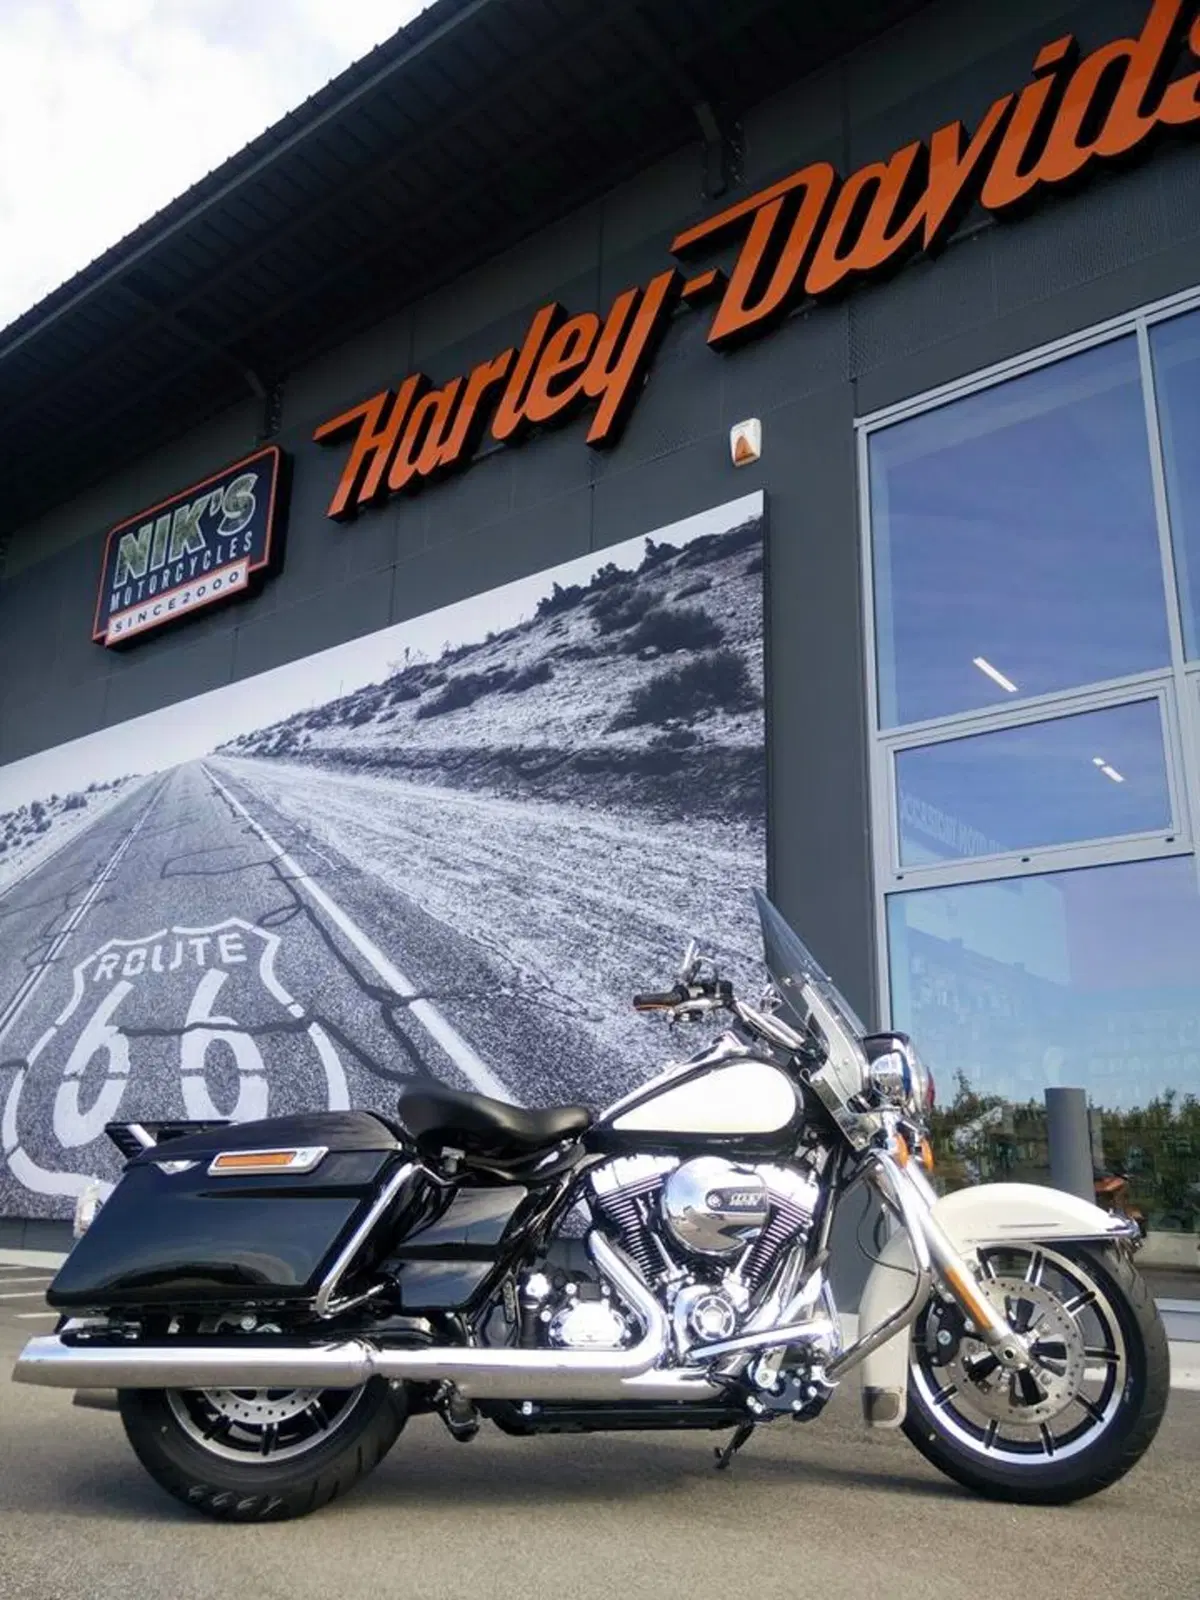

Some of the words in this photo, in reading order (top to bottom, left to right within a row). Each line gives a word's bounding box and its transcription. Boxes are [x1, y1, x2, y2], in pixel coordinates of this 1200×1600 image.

[109, 531, 252, 613] MOTORCYCLES
[113, 473, 259, 590] NIK'S
[93, 932, 248, 983] ROUTE
[53, 967, 269, 1149] 66
